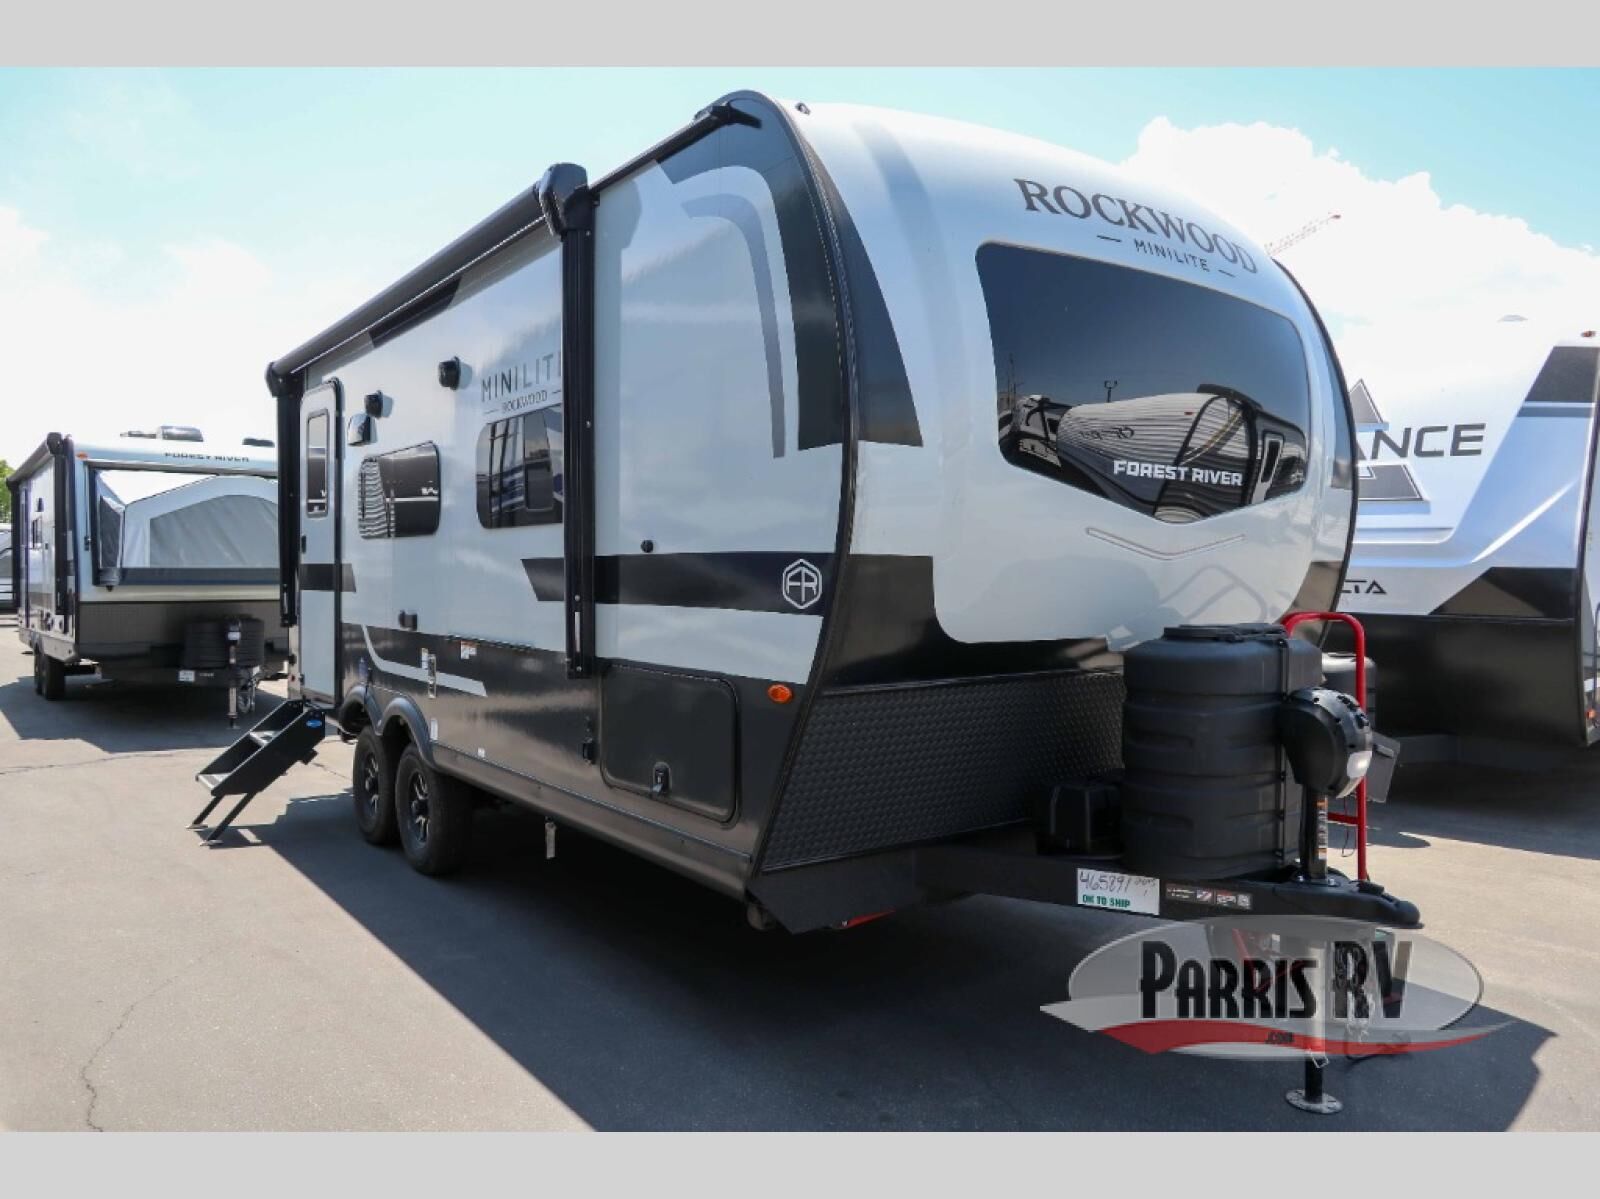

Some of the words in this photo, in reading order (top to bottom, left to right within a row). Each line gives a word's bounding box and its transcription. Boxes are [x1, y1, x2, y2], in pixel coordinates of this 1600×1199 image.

[1013, 178, 1257, 274] ROCKWOOD
[1133, 238, 1211, 272] MINILITE
[481, 352, 561, 402] MINILIT
[503, 389, 548, 412] ROCKWOOD
[164, 452, 211, 460] FOREST
[214, 455, 250, 463] RIVER
[1113, 460, 1188, 483] FOREST
[1191, 467, 1243, 486] RIVER
[1082, 894, 1095, 904] OK
[1096, 895, 1107, 906] TO
[1109, 897, 1131, 908] SHIP
